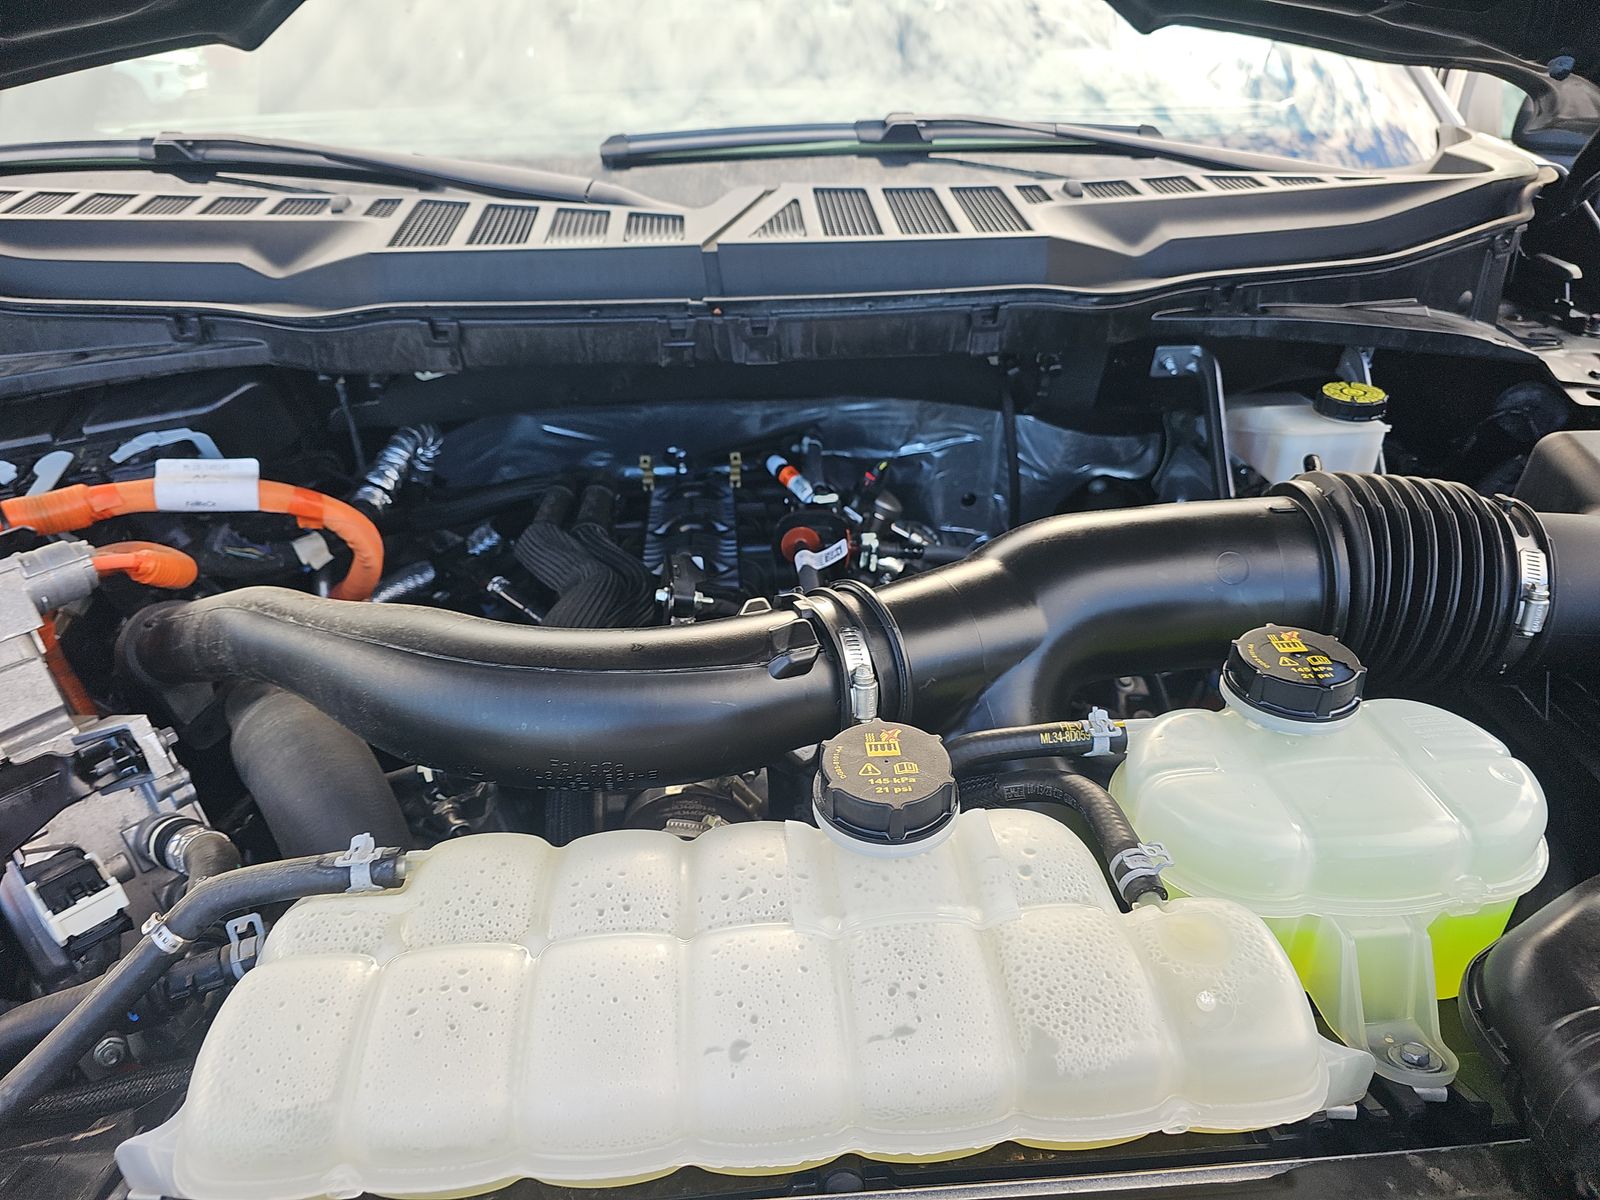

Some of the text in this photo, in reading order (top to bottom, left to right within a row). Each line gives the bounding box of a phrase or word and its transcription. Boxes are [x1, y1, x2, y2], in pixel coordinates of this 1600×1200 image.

[1059, 721, 1082, 731] HEV
[868, 777, 890, 785] 145
[875, 785, 913, 794] 21 psi
